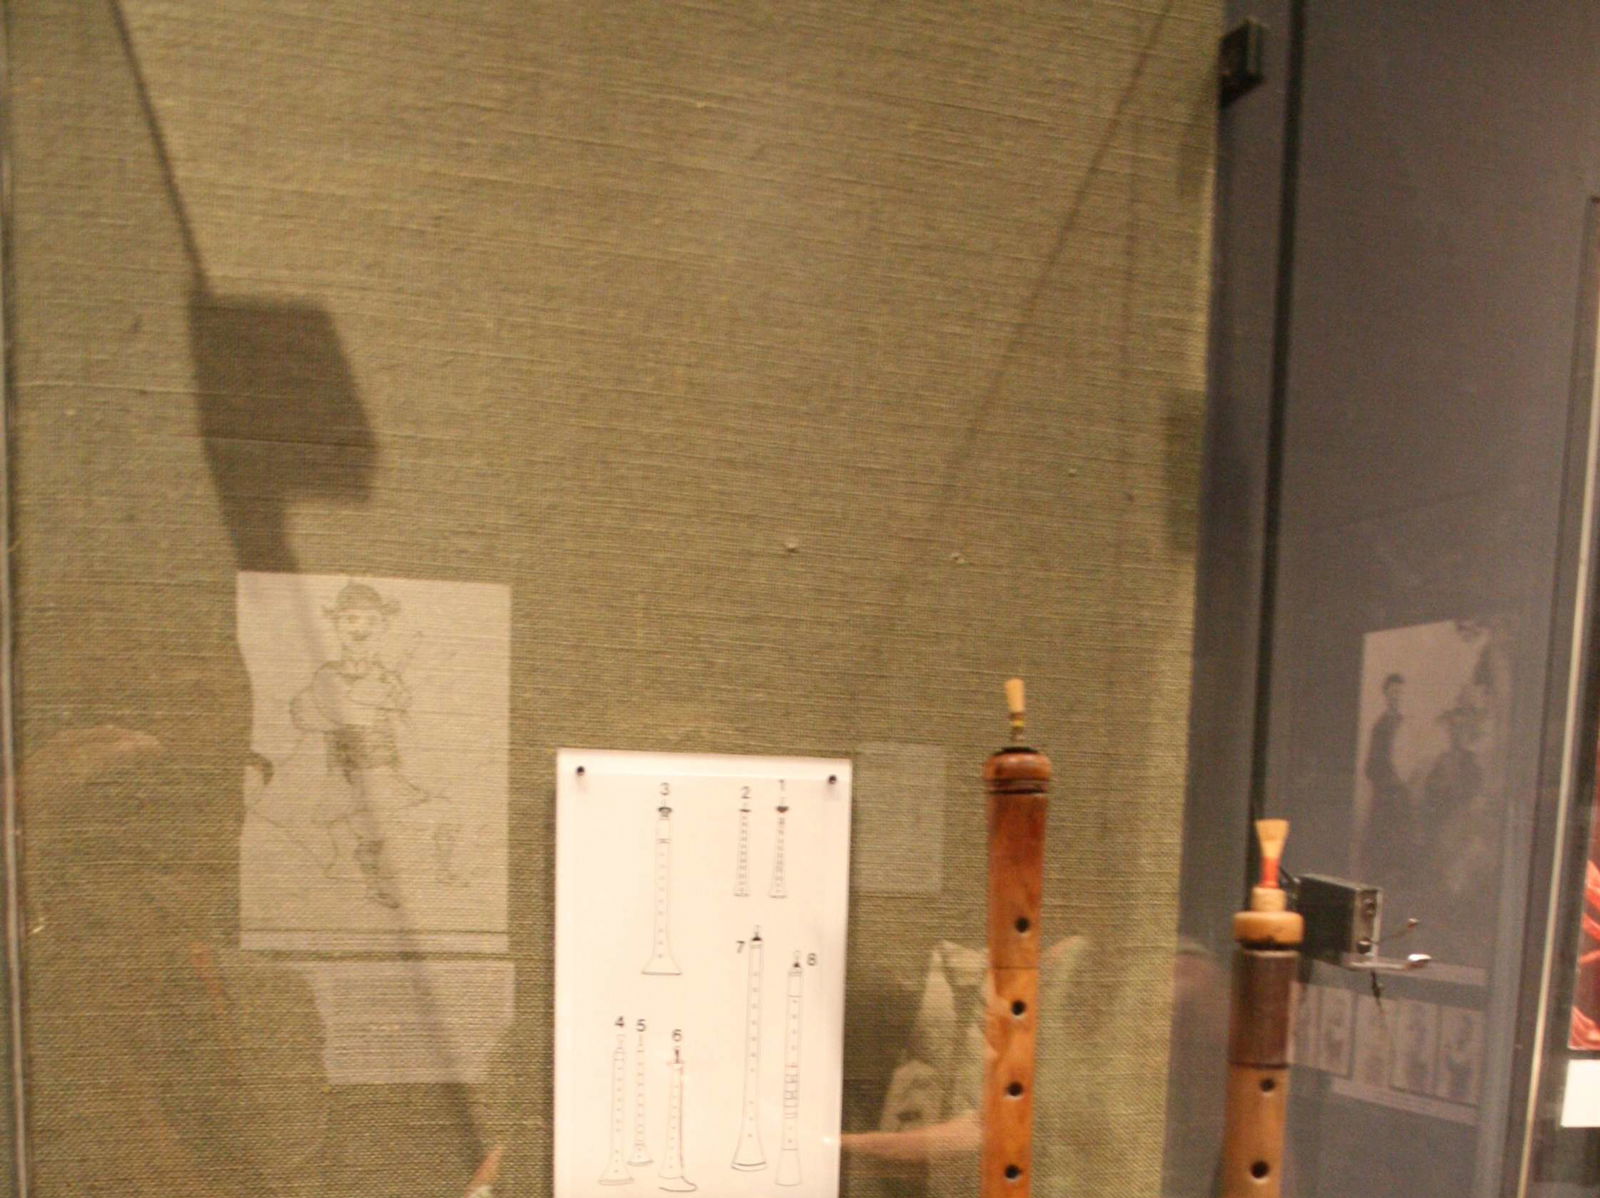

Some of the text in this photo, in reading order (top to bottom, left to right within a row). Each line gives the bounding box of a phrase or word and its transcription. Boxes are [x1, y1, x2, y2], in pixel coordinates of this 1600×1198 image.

[659, 782, 671, 796] 3
[778, 779, 785, 791] 1
[741, 786, 751, 799] 2
[736, 940, 746, 954] 7
[807, 952, 818, 966] 8
[614, 1015, 626, 1028] 4
[636, 1018, 647, 1032] 5
[671, 1028, 683, 1043] 6
